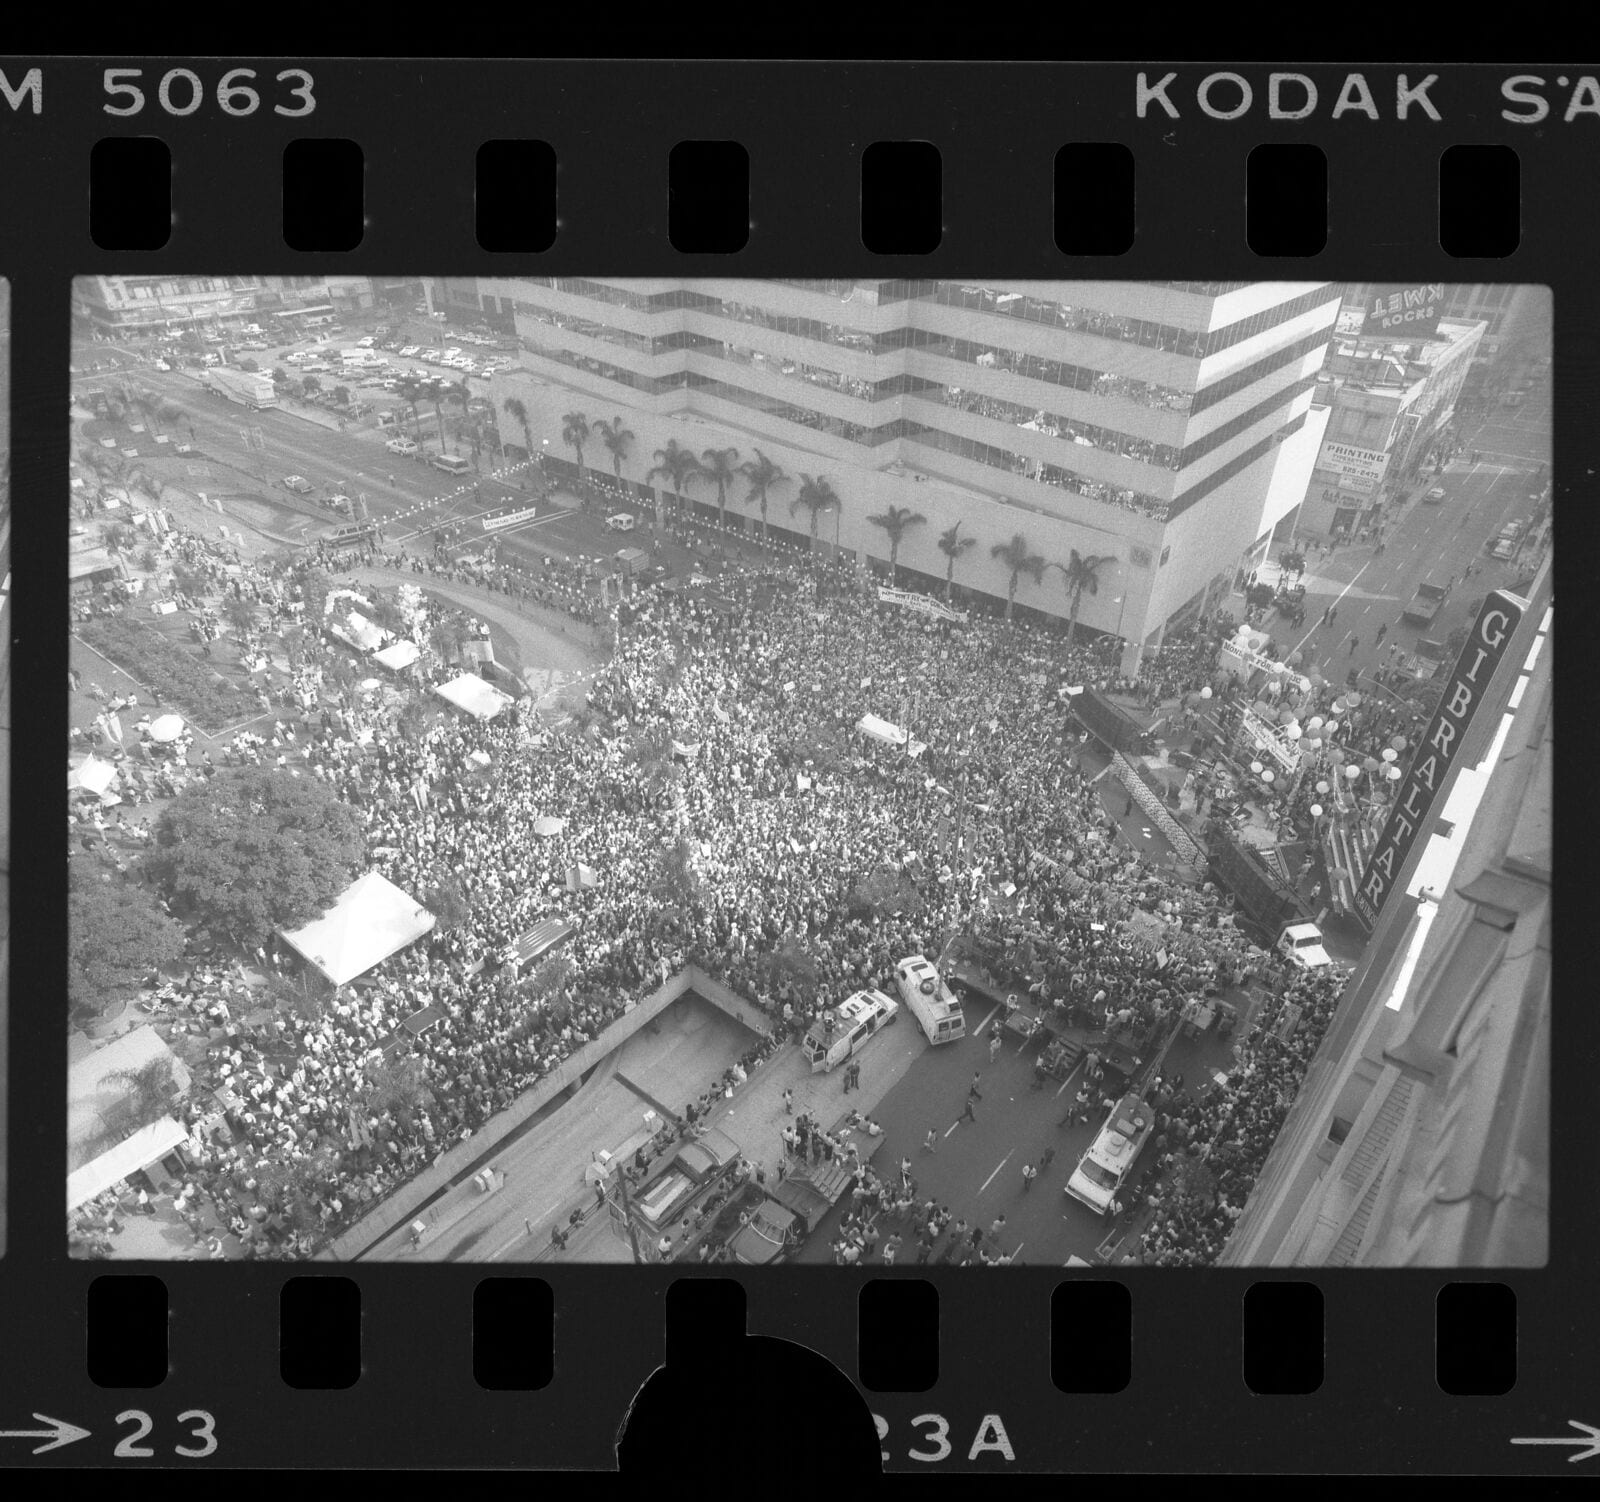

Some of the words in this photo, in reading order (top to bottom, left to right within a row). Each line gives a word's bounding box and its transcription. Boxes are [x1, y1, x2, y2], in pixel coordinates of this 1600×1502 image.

[0, 68, 43, 115] M
[103, 68, 317, 117] 5063
[1136, 72, 1442, 121] KODAK
[1382, 306, 1434, 329] ROCKS
[1327, 445, 1385, 463] PRINTING
[1364, 609, 1510, 907] GIBRALTAR
[113, 1410, 218, 1458] 23
